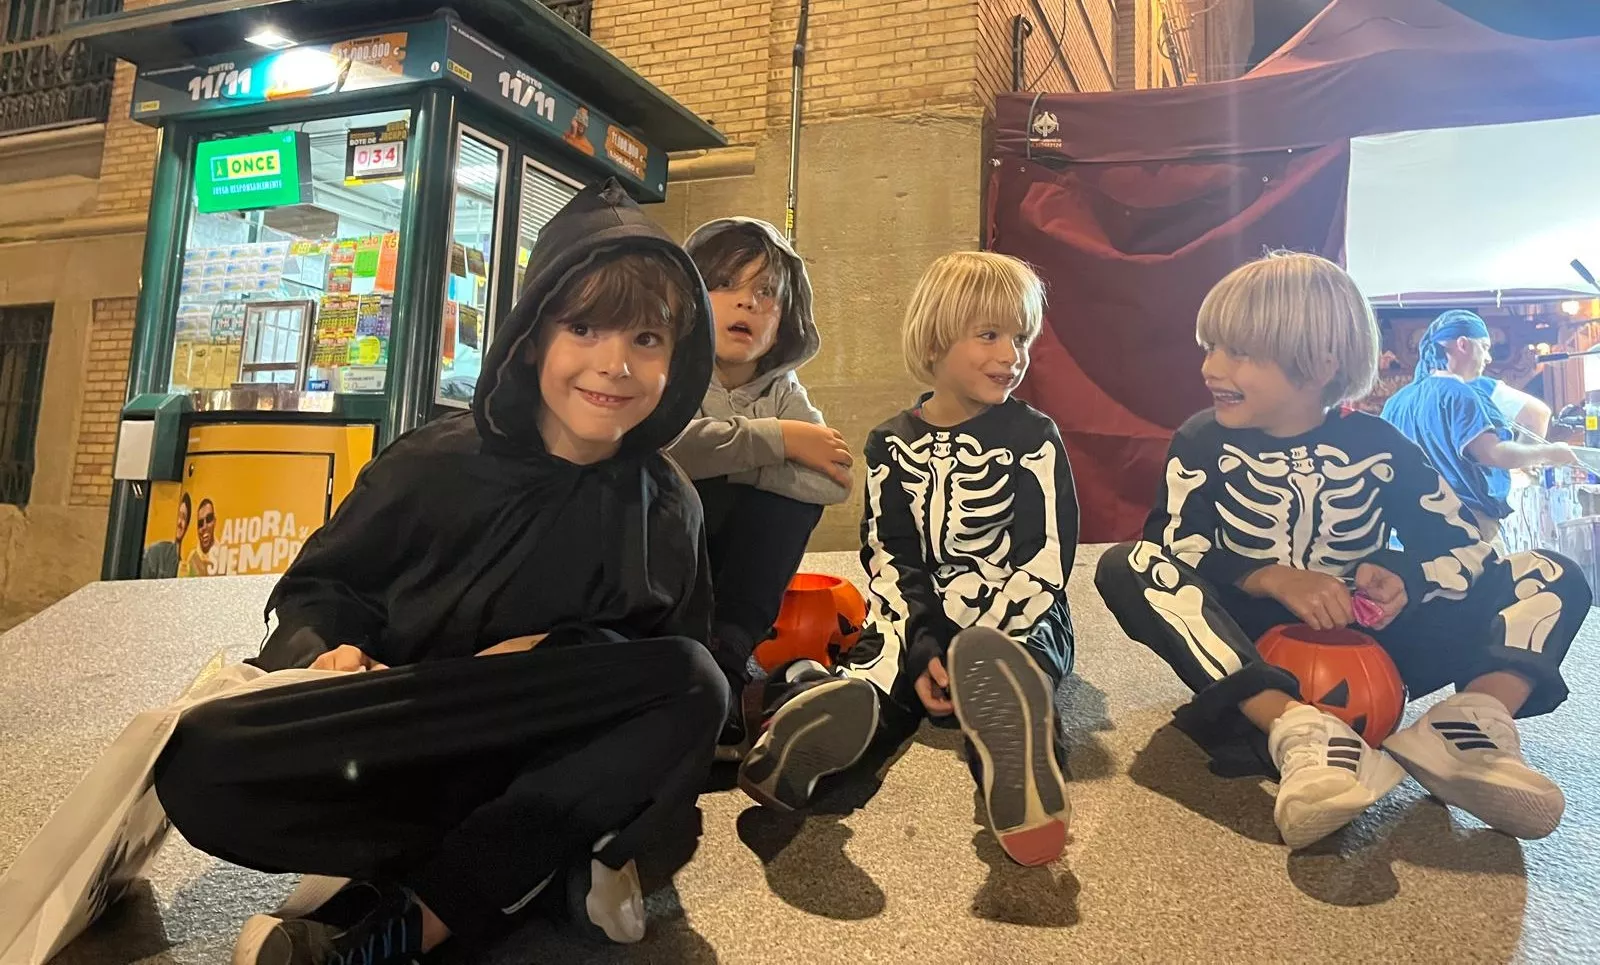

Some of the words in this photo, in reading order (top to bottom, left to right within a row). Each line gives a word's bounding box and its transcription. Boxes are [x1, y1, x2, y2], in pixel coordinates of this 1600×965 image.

[188, 67, 252, 101] 11/11
[516, 69, 542, 90] SORTEO
[499, 71, 555, 122] 11/11
[349, 138, 367, 147] BOTE
[231, 155, 276, 174] ONCE
[221, 510, 295, 544] AHORA
